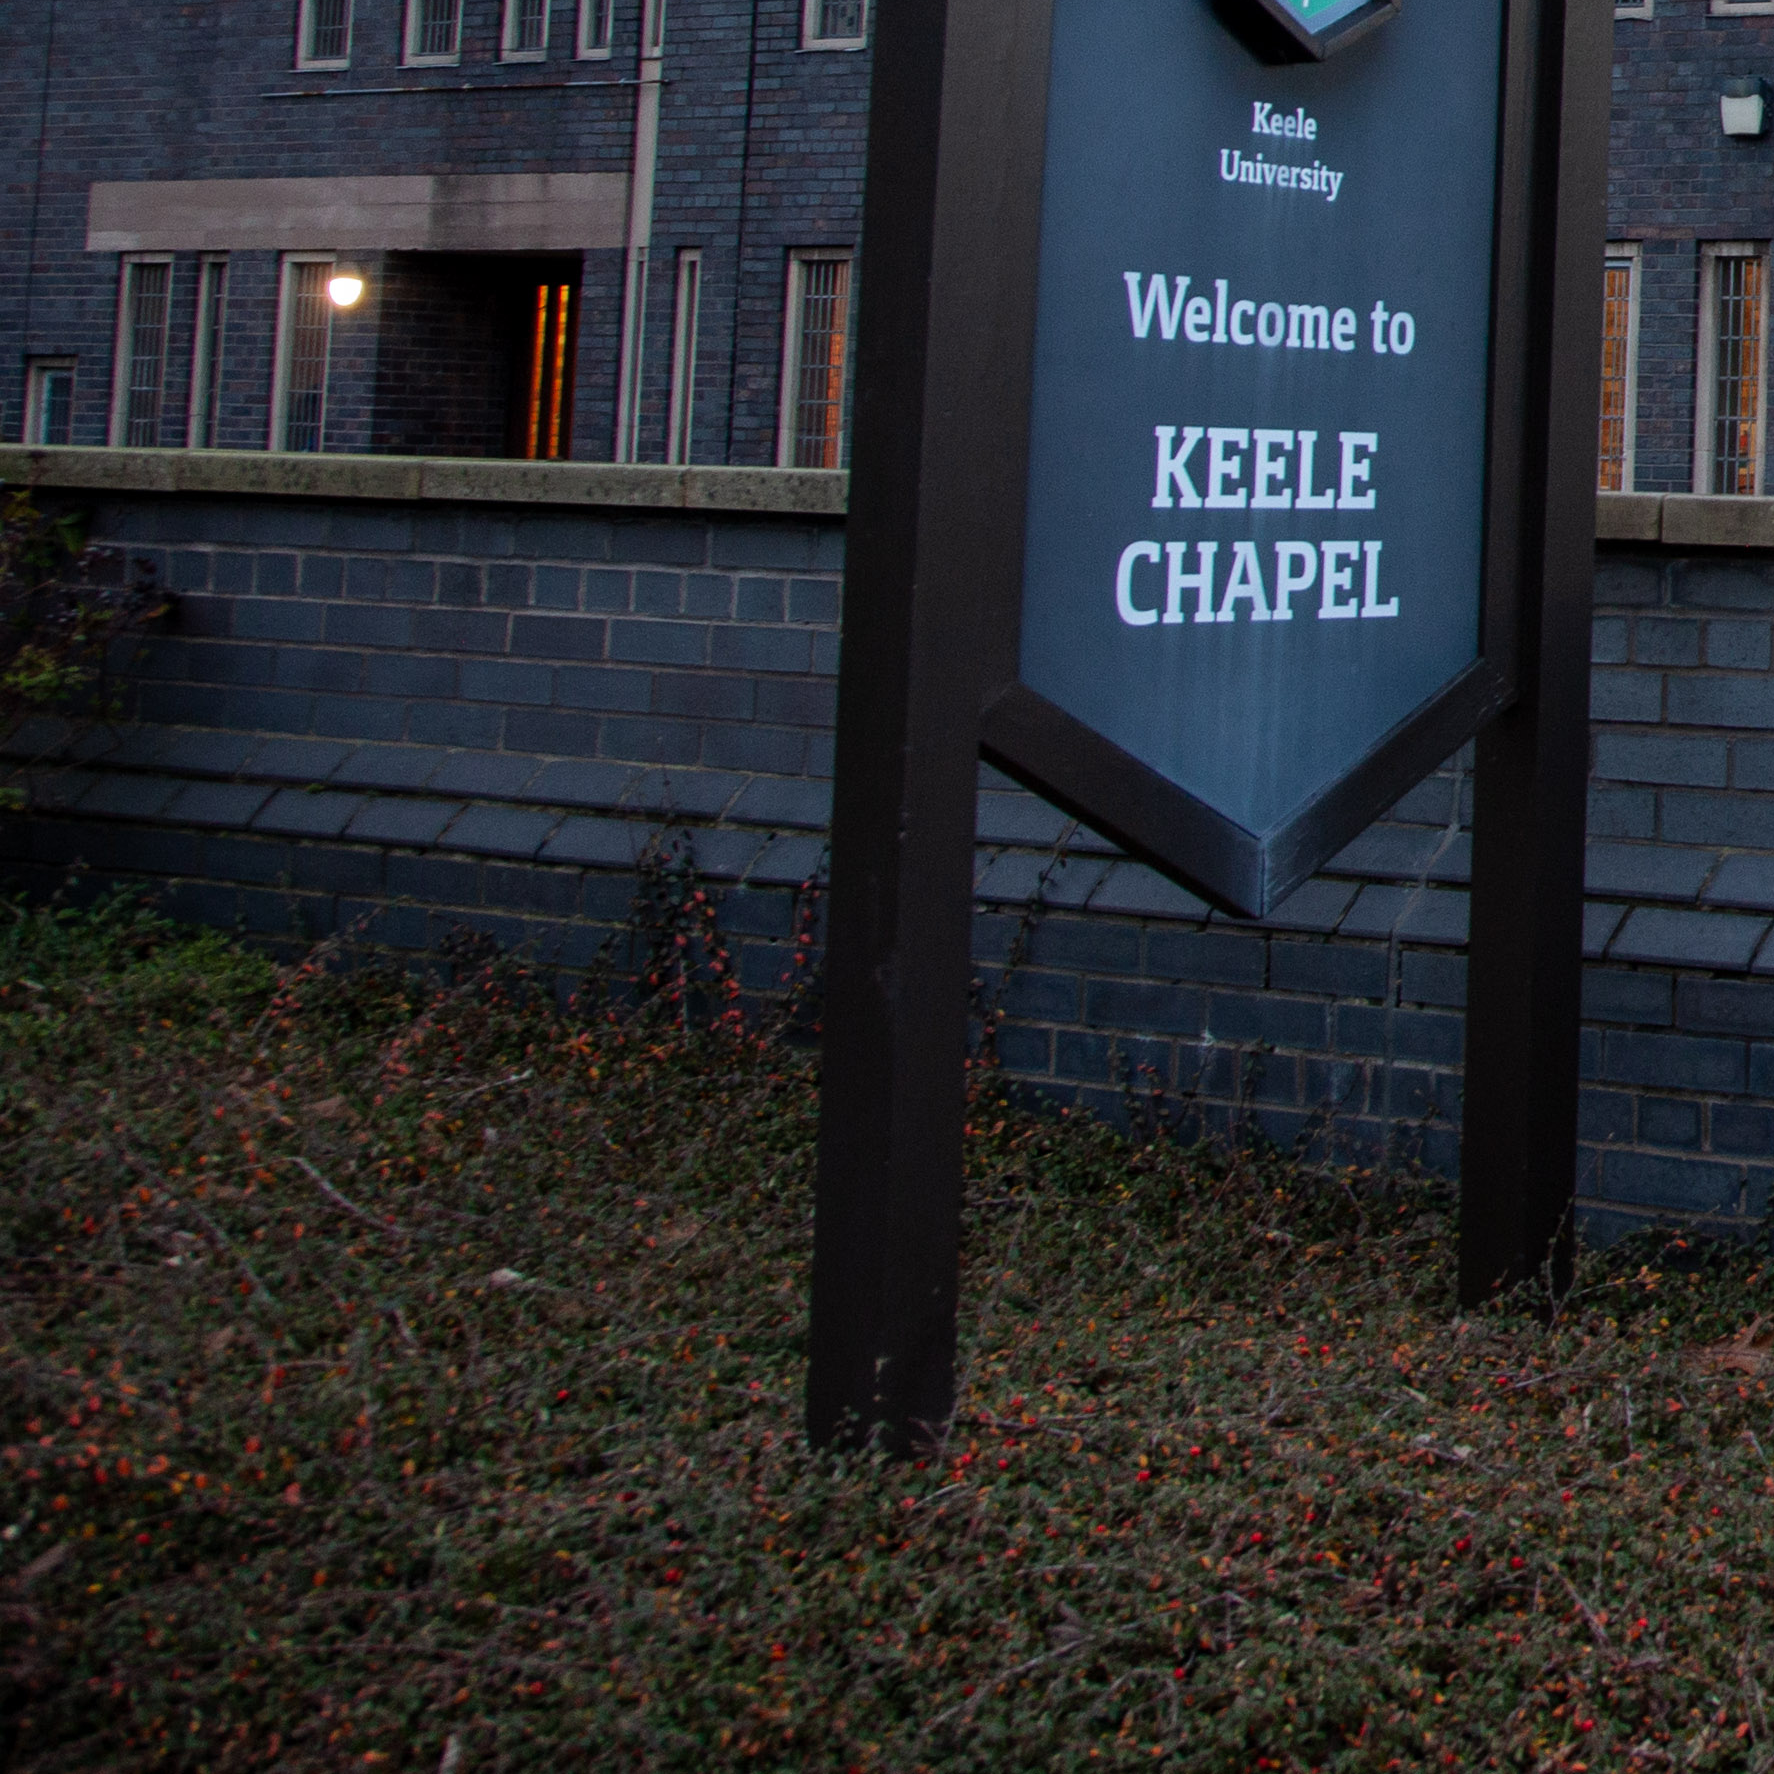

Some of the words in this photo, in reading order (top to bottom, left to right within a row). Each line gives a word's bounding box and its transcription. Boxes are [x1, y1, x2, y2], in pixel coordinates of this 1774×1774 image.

[1251, 100, 1318, 140] Keele
[1219, 148, 1344, 202] University
[1123, 272, 1357, 352] Welcome
[1370, 300, 1416, 355] to
[1150, 425, 1378, 510] KEELE
[1115, 540, 1400, 627] CHAPEL
